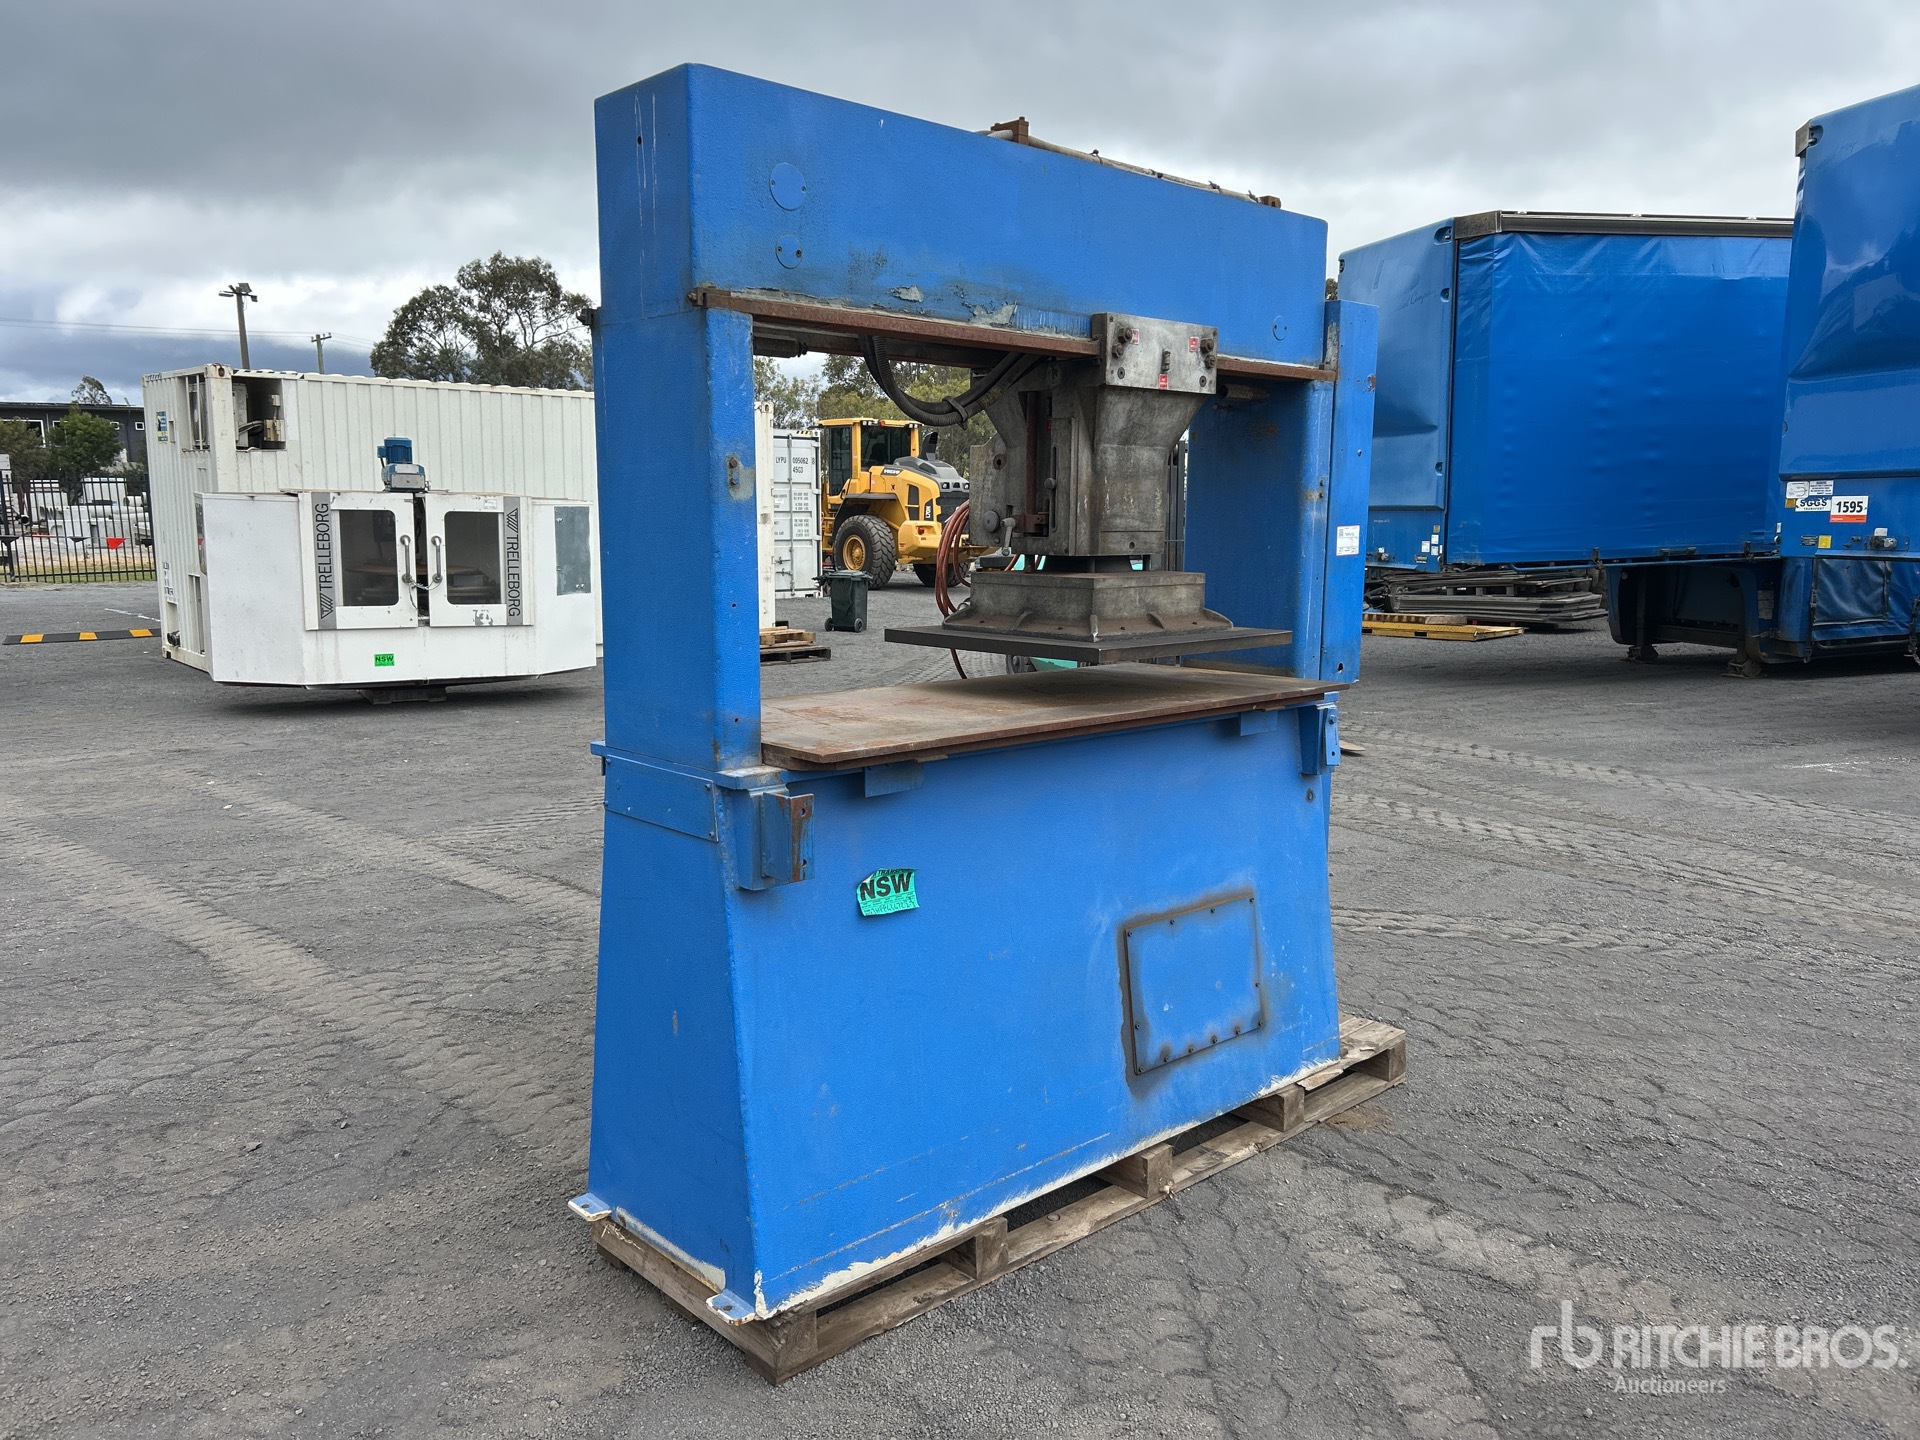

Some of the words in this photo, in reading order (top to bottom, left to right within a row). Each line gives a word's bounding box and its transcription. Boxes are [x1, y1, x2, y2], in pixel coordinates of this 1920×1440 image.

[775, 456, 787, 464] LYPU
[1836, 501, 1864, 513] 1595
[315, 503, 333, 591] TRELLEBORG
[506, 534, 521, 617] TRELLEBORG
[860, 871, 912, 902] NSW
